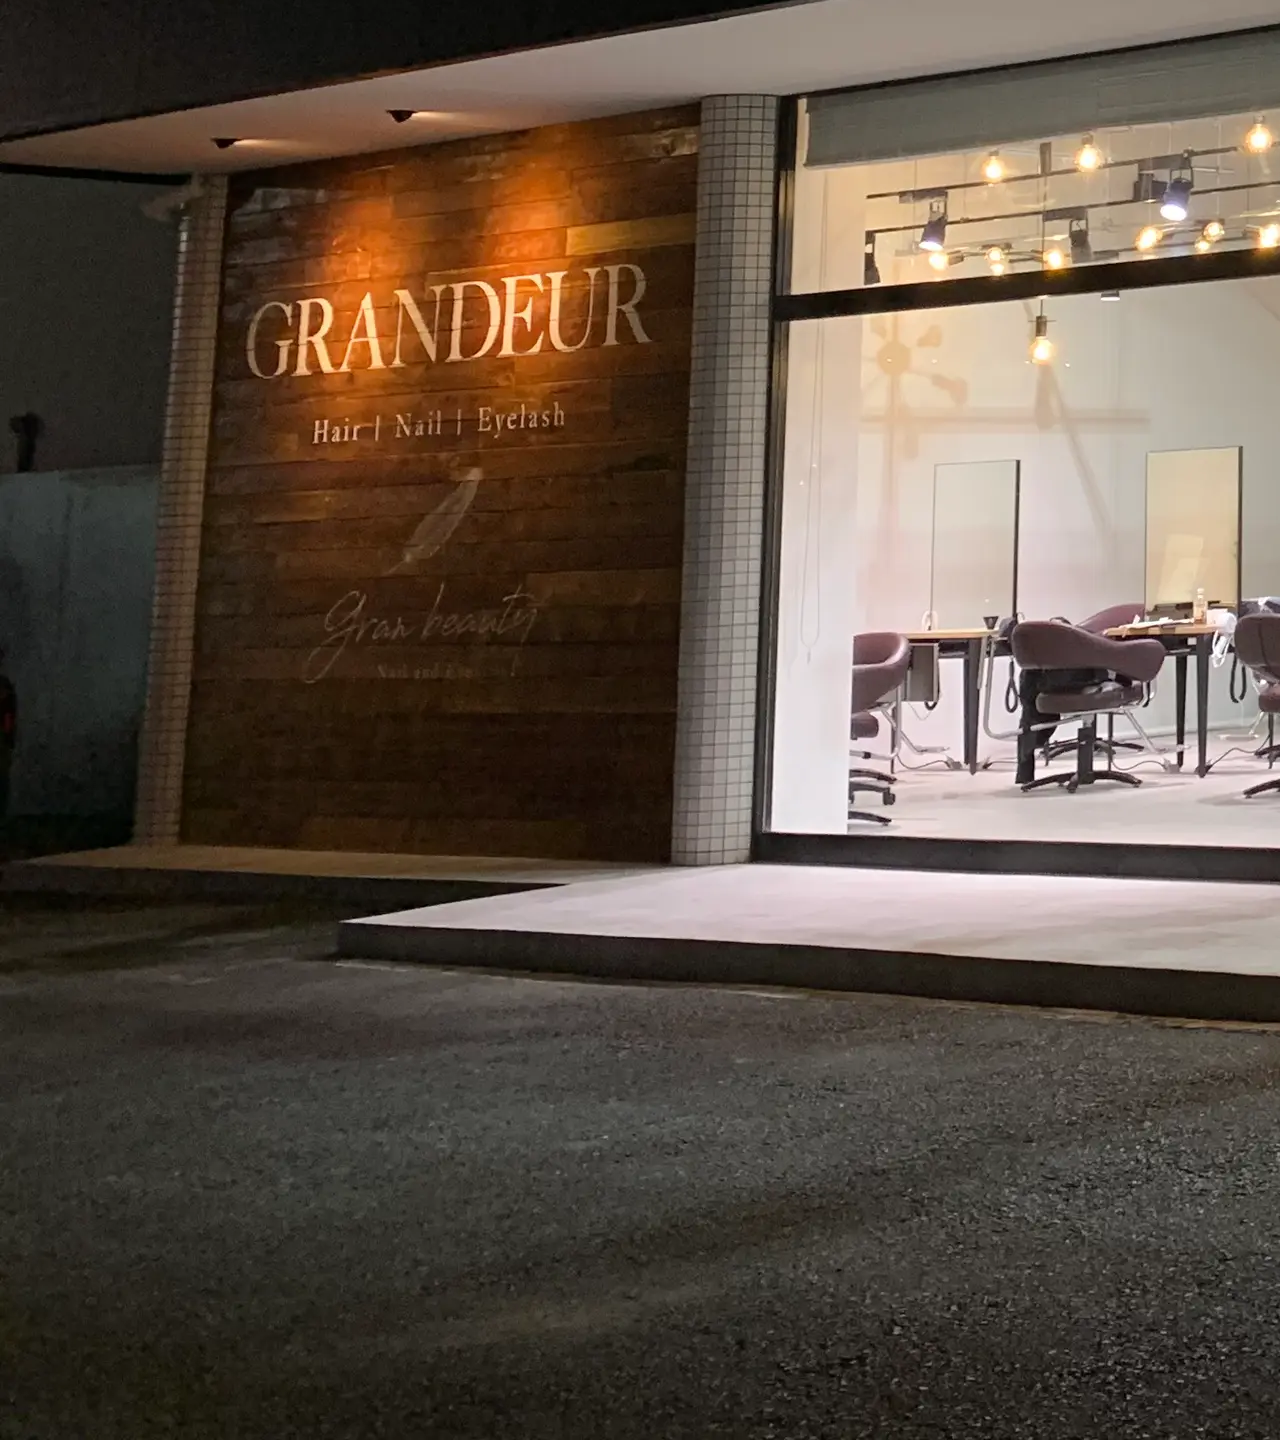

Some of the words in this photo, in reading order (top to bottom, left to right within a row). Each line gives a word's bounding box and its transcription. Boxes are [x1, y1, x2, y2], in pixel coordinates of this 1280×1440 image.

[247, 263, 653, 380] GRANDEUR
[312, 417, 361, 444] Hair
[395, 410, 442, 438] Nail
[477, 401, 565, 439] Eyelash
[305, 590, 415, 684] Gran
[420, 582, 538, 676] beauty
